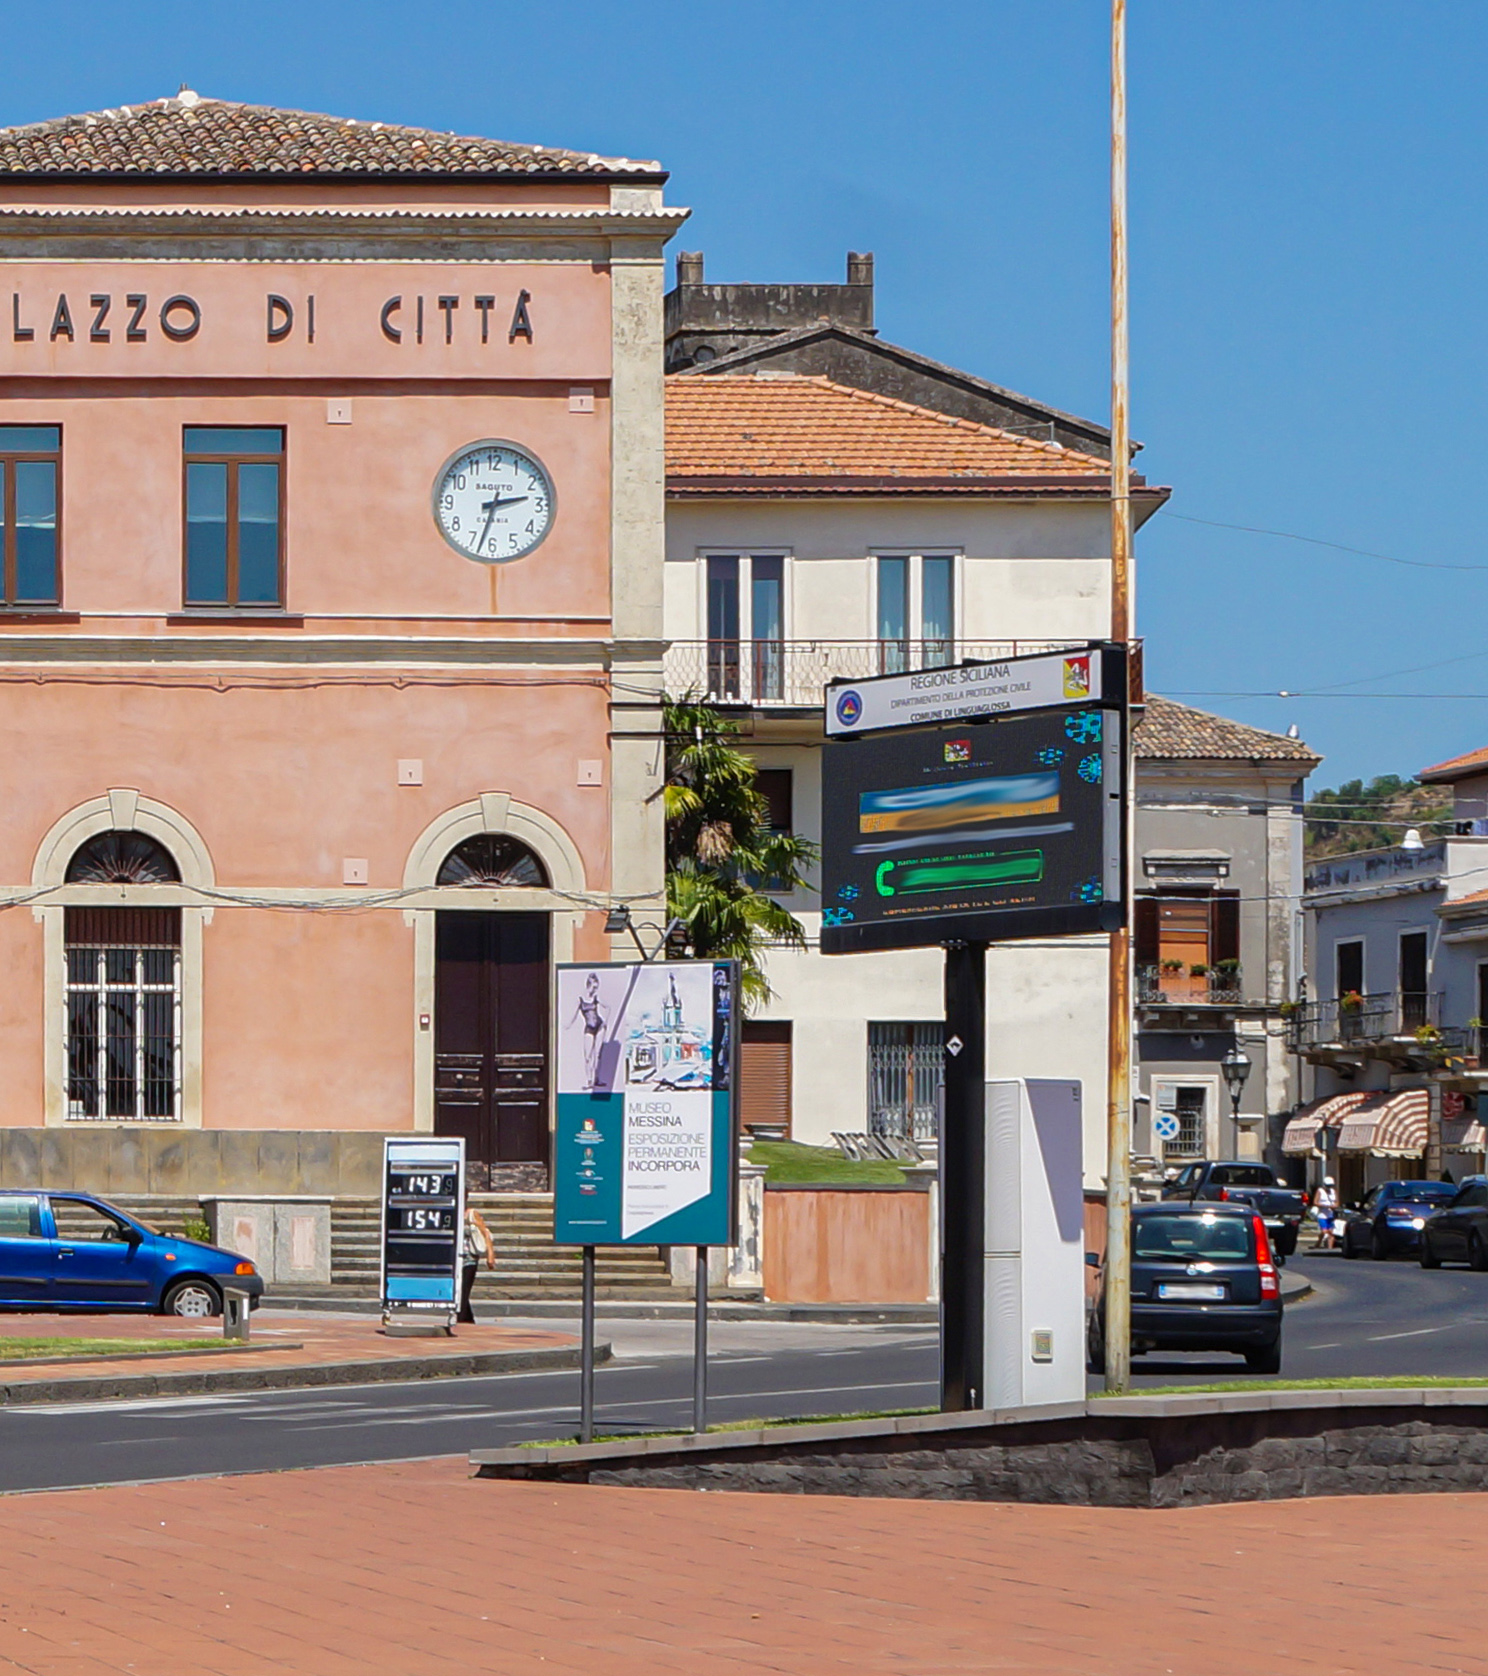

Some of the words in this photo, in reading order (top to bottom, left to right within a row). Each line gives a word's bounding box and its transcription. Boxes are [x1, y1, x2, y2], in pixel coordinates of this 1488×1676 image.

[267, 294, 314, 344] DI
[469, 459, 479, 476] 11
[487, 454, 501, 471] 12
[513, 459, 518, 476] 1
[451, 474, 466, 490] 10
[527, 475, 536, 491] 2
[444, 495, 453, 510] 9
[534, 497, 543, 513] 3
[452, 516, 460, 531] 8
[525, 520, 534, 534] 4
[468, 531, 477, 547] 7
[488, 537, 497, 553] 6
[509, 533, 518, 549] 5
[910, 671, 957, 690] REGIONE
[959, 664, 1011, 683] SICILIANA
[890, 693, 941, 709] DIPARTIMENTO
[628, 1102, 672, 1114] MUSEO
[628, 1115, 683, 1127] MESSINA
[628, 1132, 706, 1145] ESPOSIZIONE
[627, 1146, 708, 1159] PERMANENTE
[627, 1160, 701, 1172] INCORPORA
